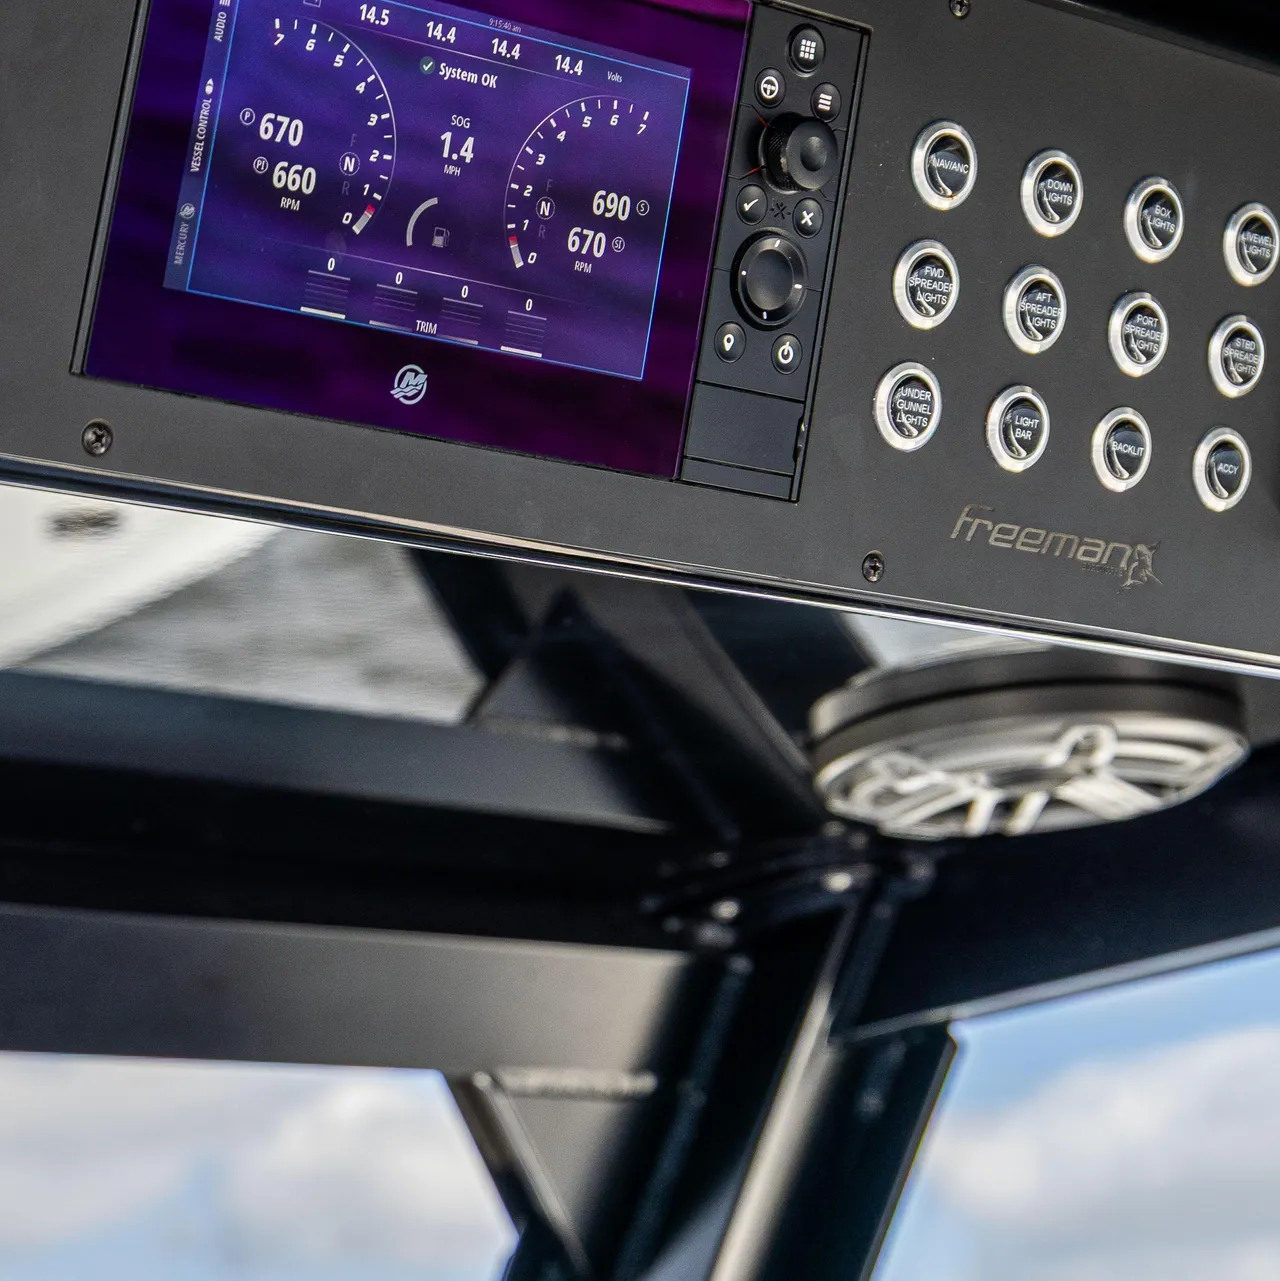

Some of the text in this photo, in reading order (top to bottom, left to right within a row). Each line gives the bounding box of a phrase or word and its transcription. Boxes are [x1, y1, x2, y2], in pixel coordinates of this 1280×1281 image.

[213, 11, 227, 42] AUDIO
[359, 3, 623, 84] 14.5 14.4 14.4 14.4 Volts
[438, 62, 498, 89] System OK
[273, 33, 380, 225] 7 6 5 4 3 2 1 0
[450, 114, 471, 129] SOG
[190, 97, 213, 172] VESSEL CONTROL
[259, 112, 304, 147] 670
[440, 131, 475, 163] 1.4
[343, 156, 356, 173] N
[443, 164, 461, 177] MPH
[934, 158, 969, 174] NAV/ANC
[272, 161, 317, 195] 660
[1046, 179, 1074, 192] DOWN
[522, 114, 647, 264] 0 1 2 3 4 5 6 7
[280, 196, 300, 211] RPM
[592, 189, 631, 222] 690
[1043, 192, 1073, 206] LIGHTS
[539, 201, 551, 217] N
[1154, 204, 1172, 218] BOX
[1149, 217, 1176, 233] LIGHTS
[174, 221, 190, 266] MERCURY
[567, 226, 607, 258] 670
[1245, 245, 1272, 258] LIGHTS
[574, 260, 593, 274] RPM
[924, 266, 945, 279] FWD
[327, 257, 533, 311] 0 0 0 0
[916, 291, 948, 305] LIGHTS
[1036, 291, 1053, 304] AFT
[415, 319, 438, 335] TRIM
[1028, 317, 1057, 330] LIGHTS
[1136, 313, 1159, 327] PORT
[1131, 338, 1160, 353] LIGHTS
[1235, 337, 1256, 351] STBD
[1230, 361, 1258, 376] LIGHTS
[900, 387, 932, 401] UNDER
[896, 399, 932, 415] GUNNEL
[896, 413, 928, 427] LIGHTS
[1015, 414, 1040, 429] LIGHT
[1015, 428, 1032, 441] BAR
[1111, 440, 1145, 457] BACKLIT
[1217, 462, 1239, 475] ACCY
[950, 503, 1133, 570] freeman
